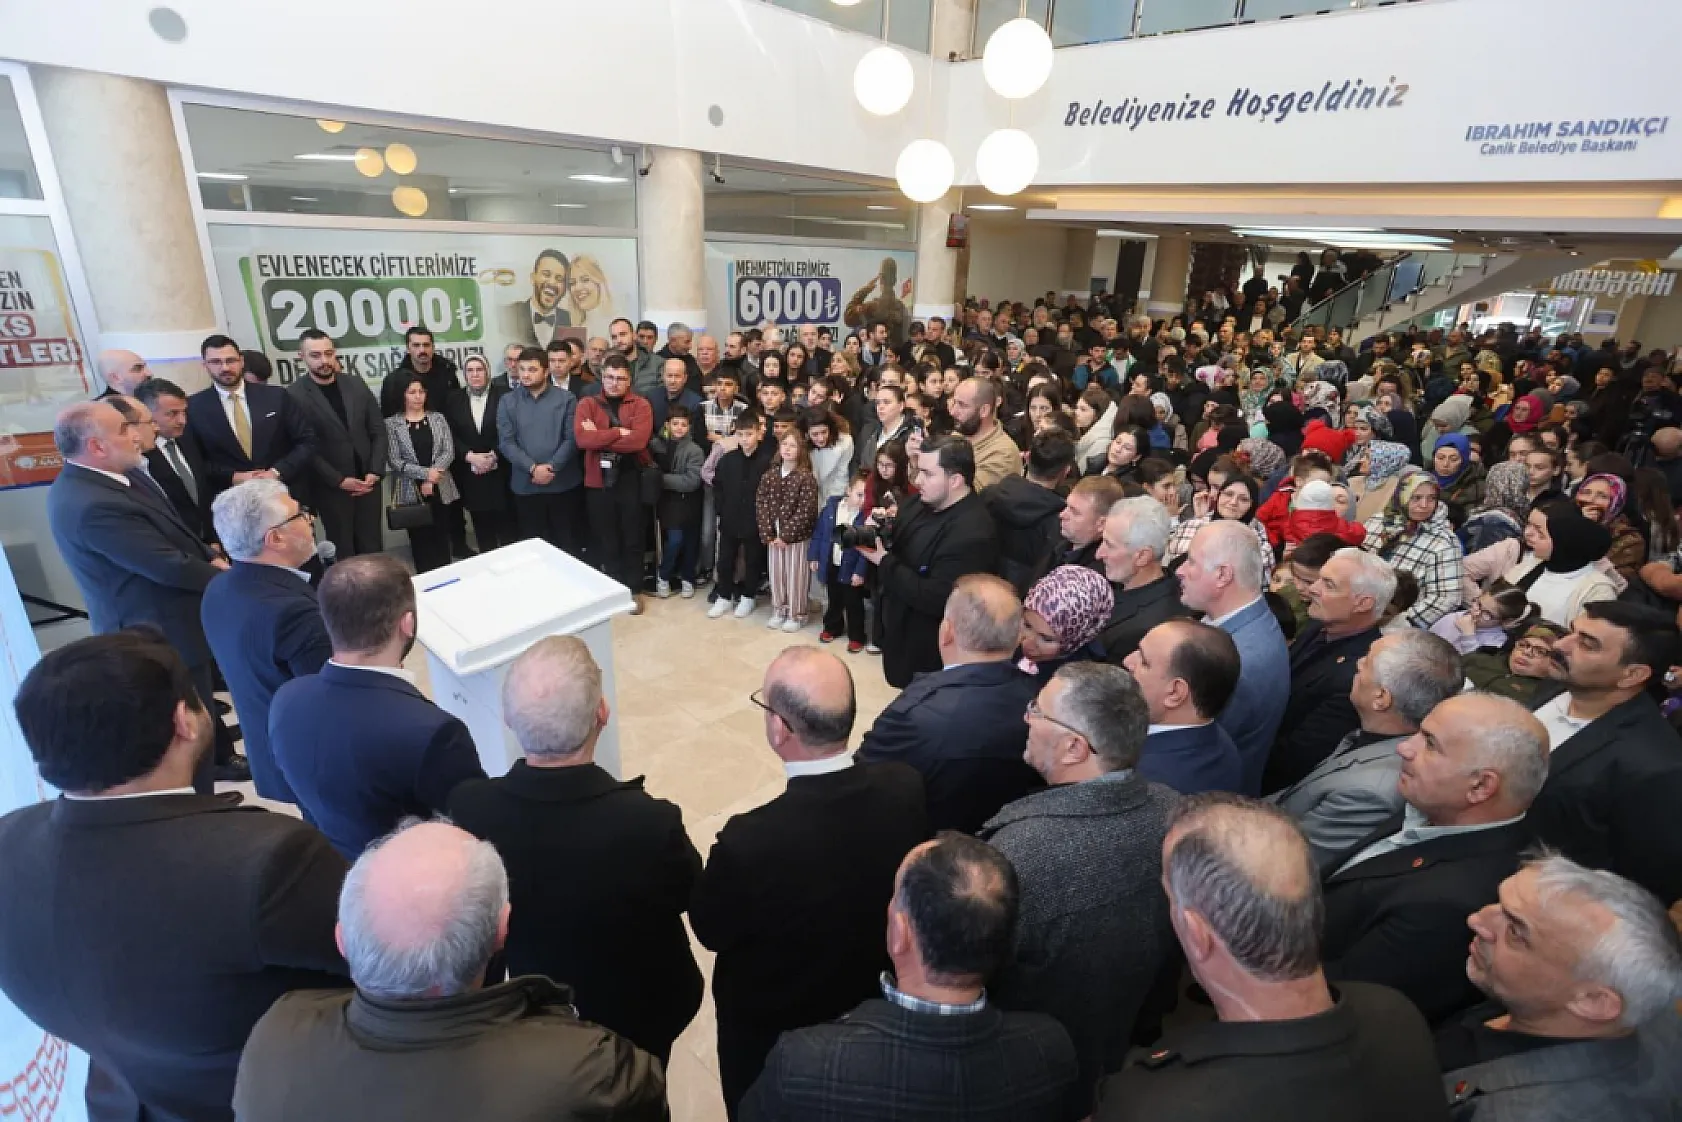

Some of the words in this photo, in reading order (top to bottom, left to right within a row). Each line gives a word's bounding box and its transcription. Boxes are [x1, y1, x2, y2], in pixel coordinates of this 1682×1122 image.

[1063, 93, 1215, 131] Belediyenize
[1226, 75, 1410, 123] Hoşgeldiniz
[1556, 116, 1669, 138] SANDIKÇI
[1480, 141, 1517, 155] Canik
[1518, 140, 1577, 156] Belediye
[257, 253, 367, 278] EVLENECEK
[370, 252, 478, 280] ÇİFTLERİMİZE
